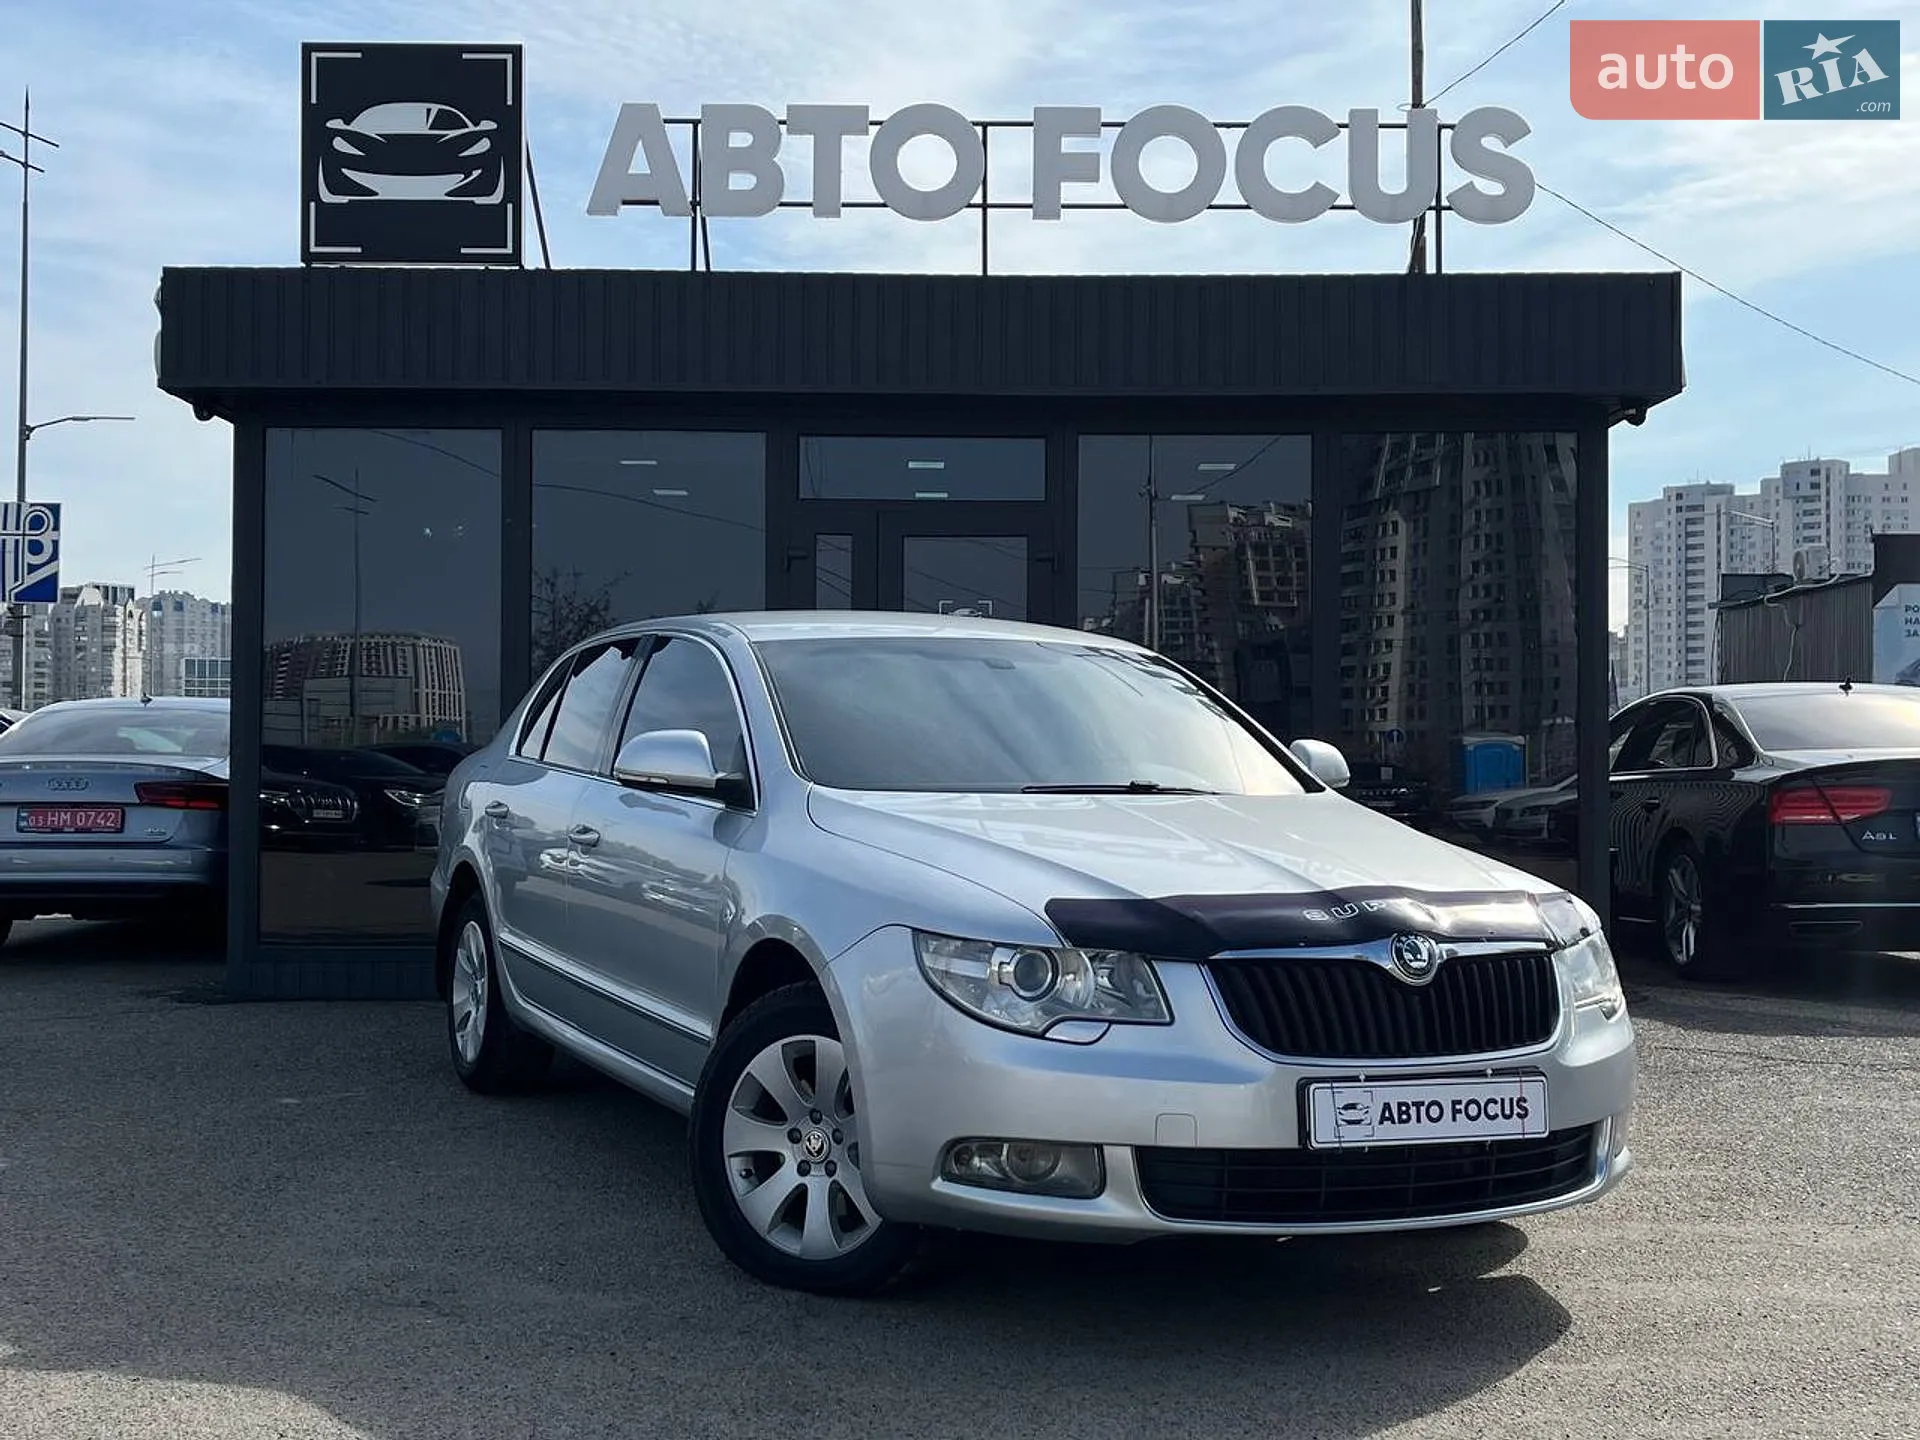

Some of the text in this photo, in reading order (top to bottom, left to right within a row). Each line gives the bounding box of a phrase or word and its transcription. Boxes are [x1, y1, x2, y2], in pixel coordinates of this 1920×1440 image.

[586, 102, 1537, 225] АВТО FOCUS
[76, 811, 116, 827] 0742
[1378, 1096, 1530, 1126] АВТО FOCUS
